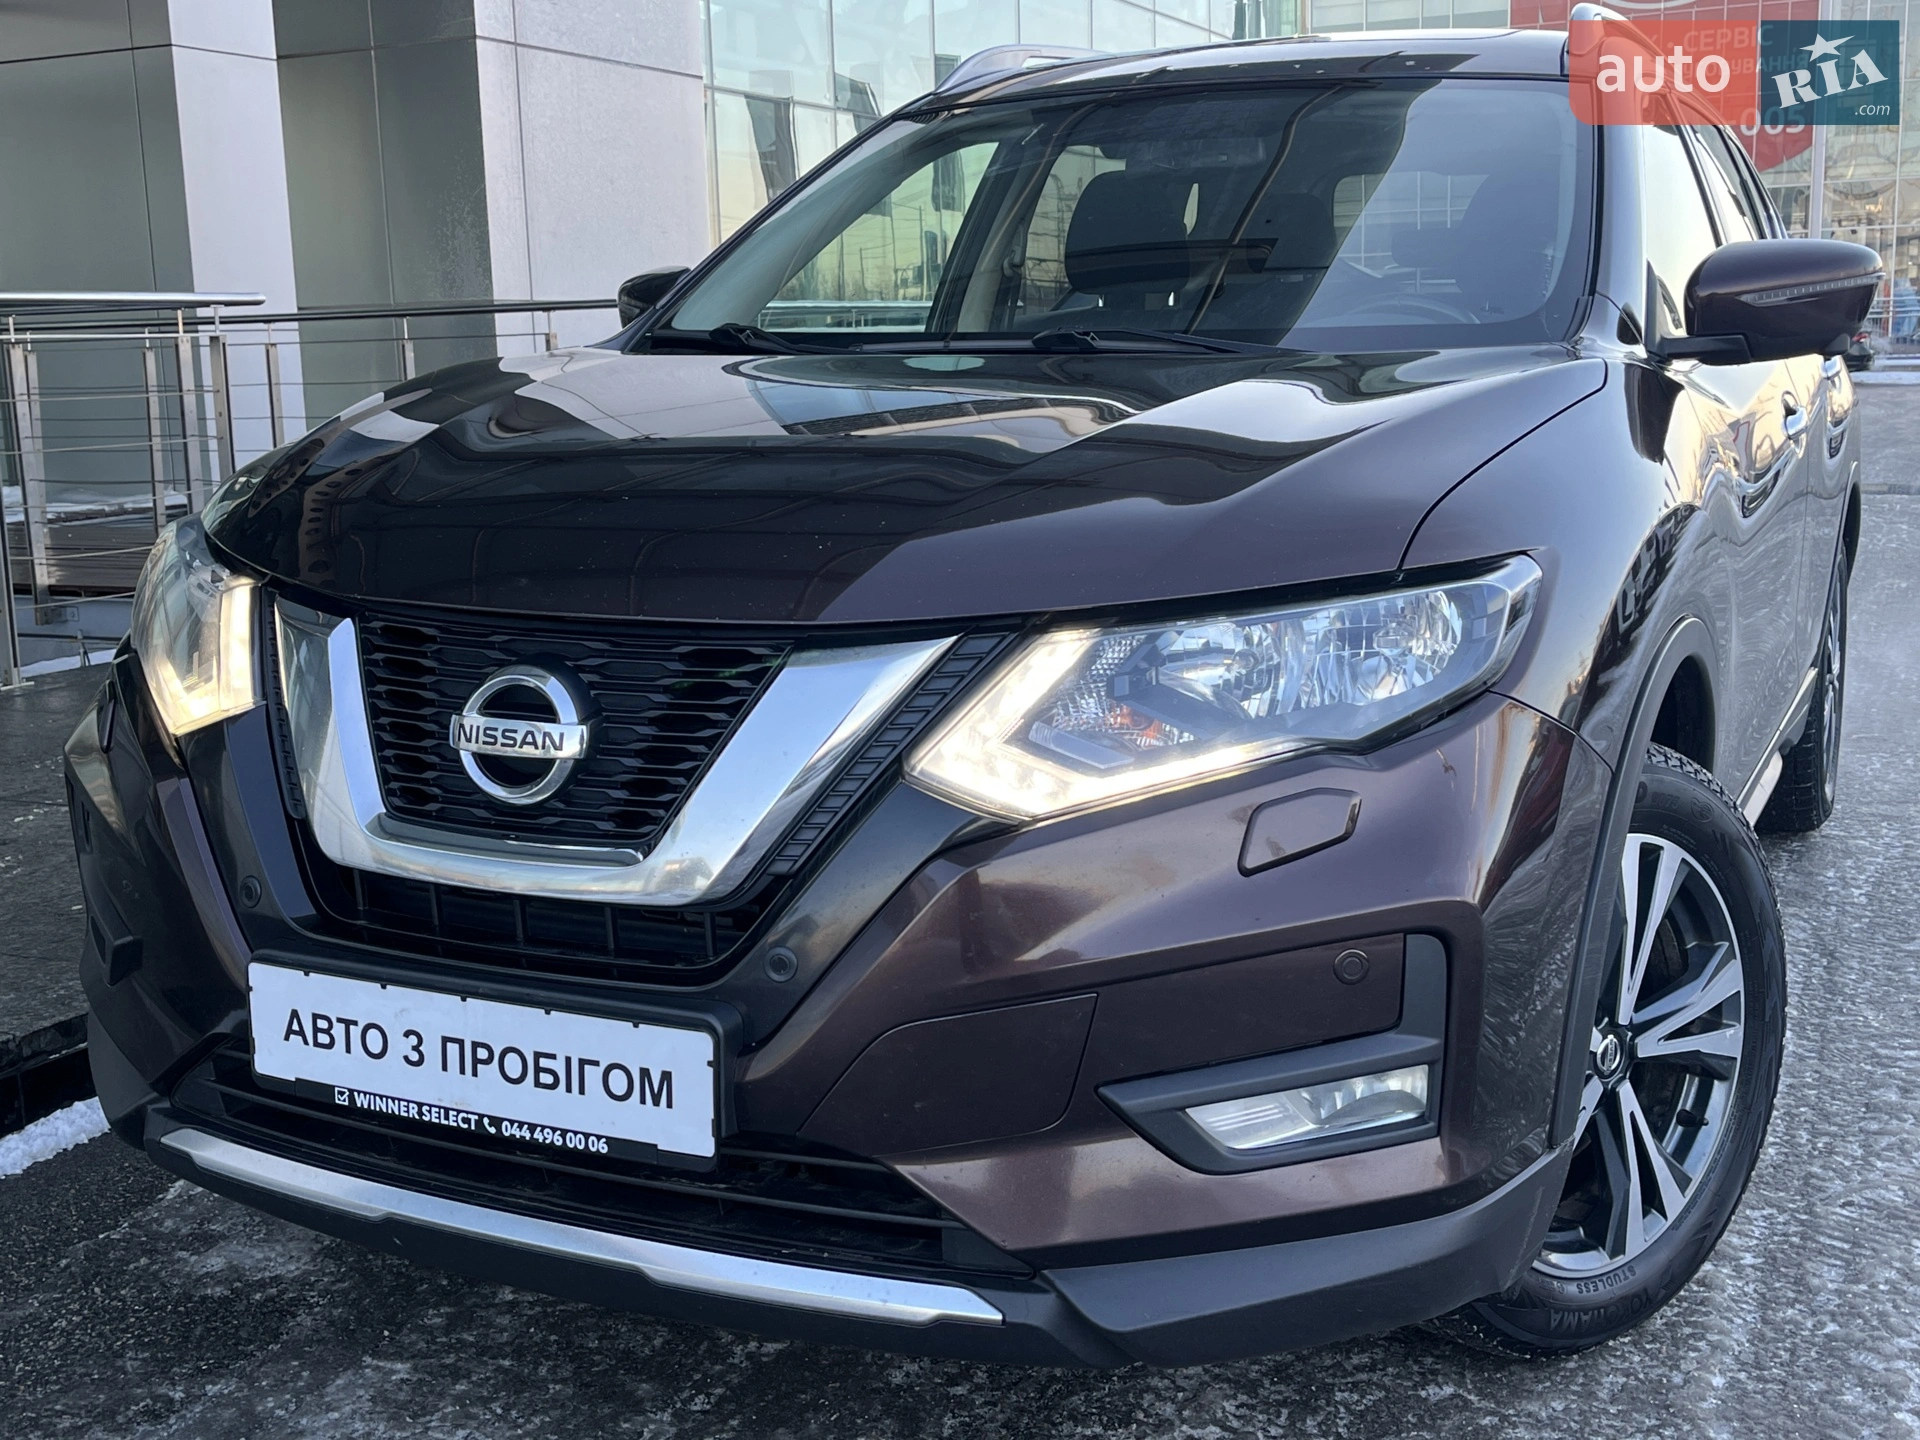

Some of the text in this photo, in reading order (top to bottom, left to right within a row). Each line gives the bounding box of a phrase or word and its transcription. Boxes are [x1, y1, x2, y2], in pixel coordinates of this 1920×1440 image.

[457, 723, 565, 751] NISSAN
[283, 1009, 389, 1060] АВТО
[441, 1035, 674, 1109] ПРОБІГОМ
[353, 1091, 609, 1154] WINNER SELECT 044 496 00 06
[1576, 1264, 1636, 1294] STUDLESS
